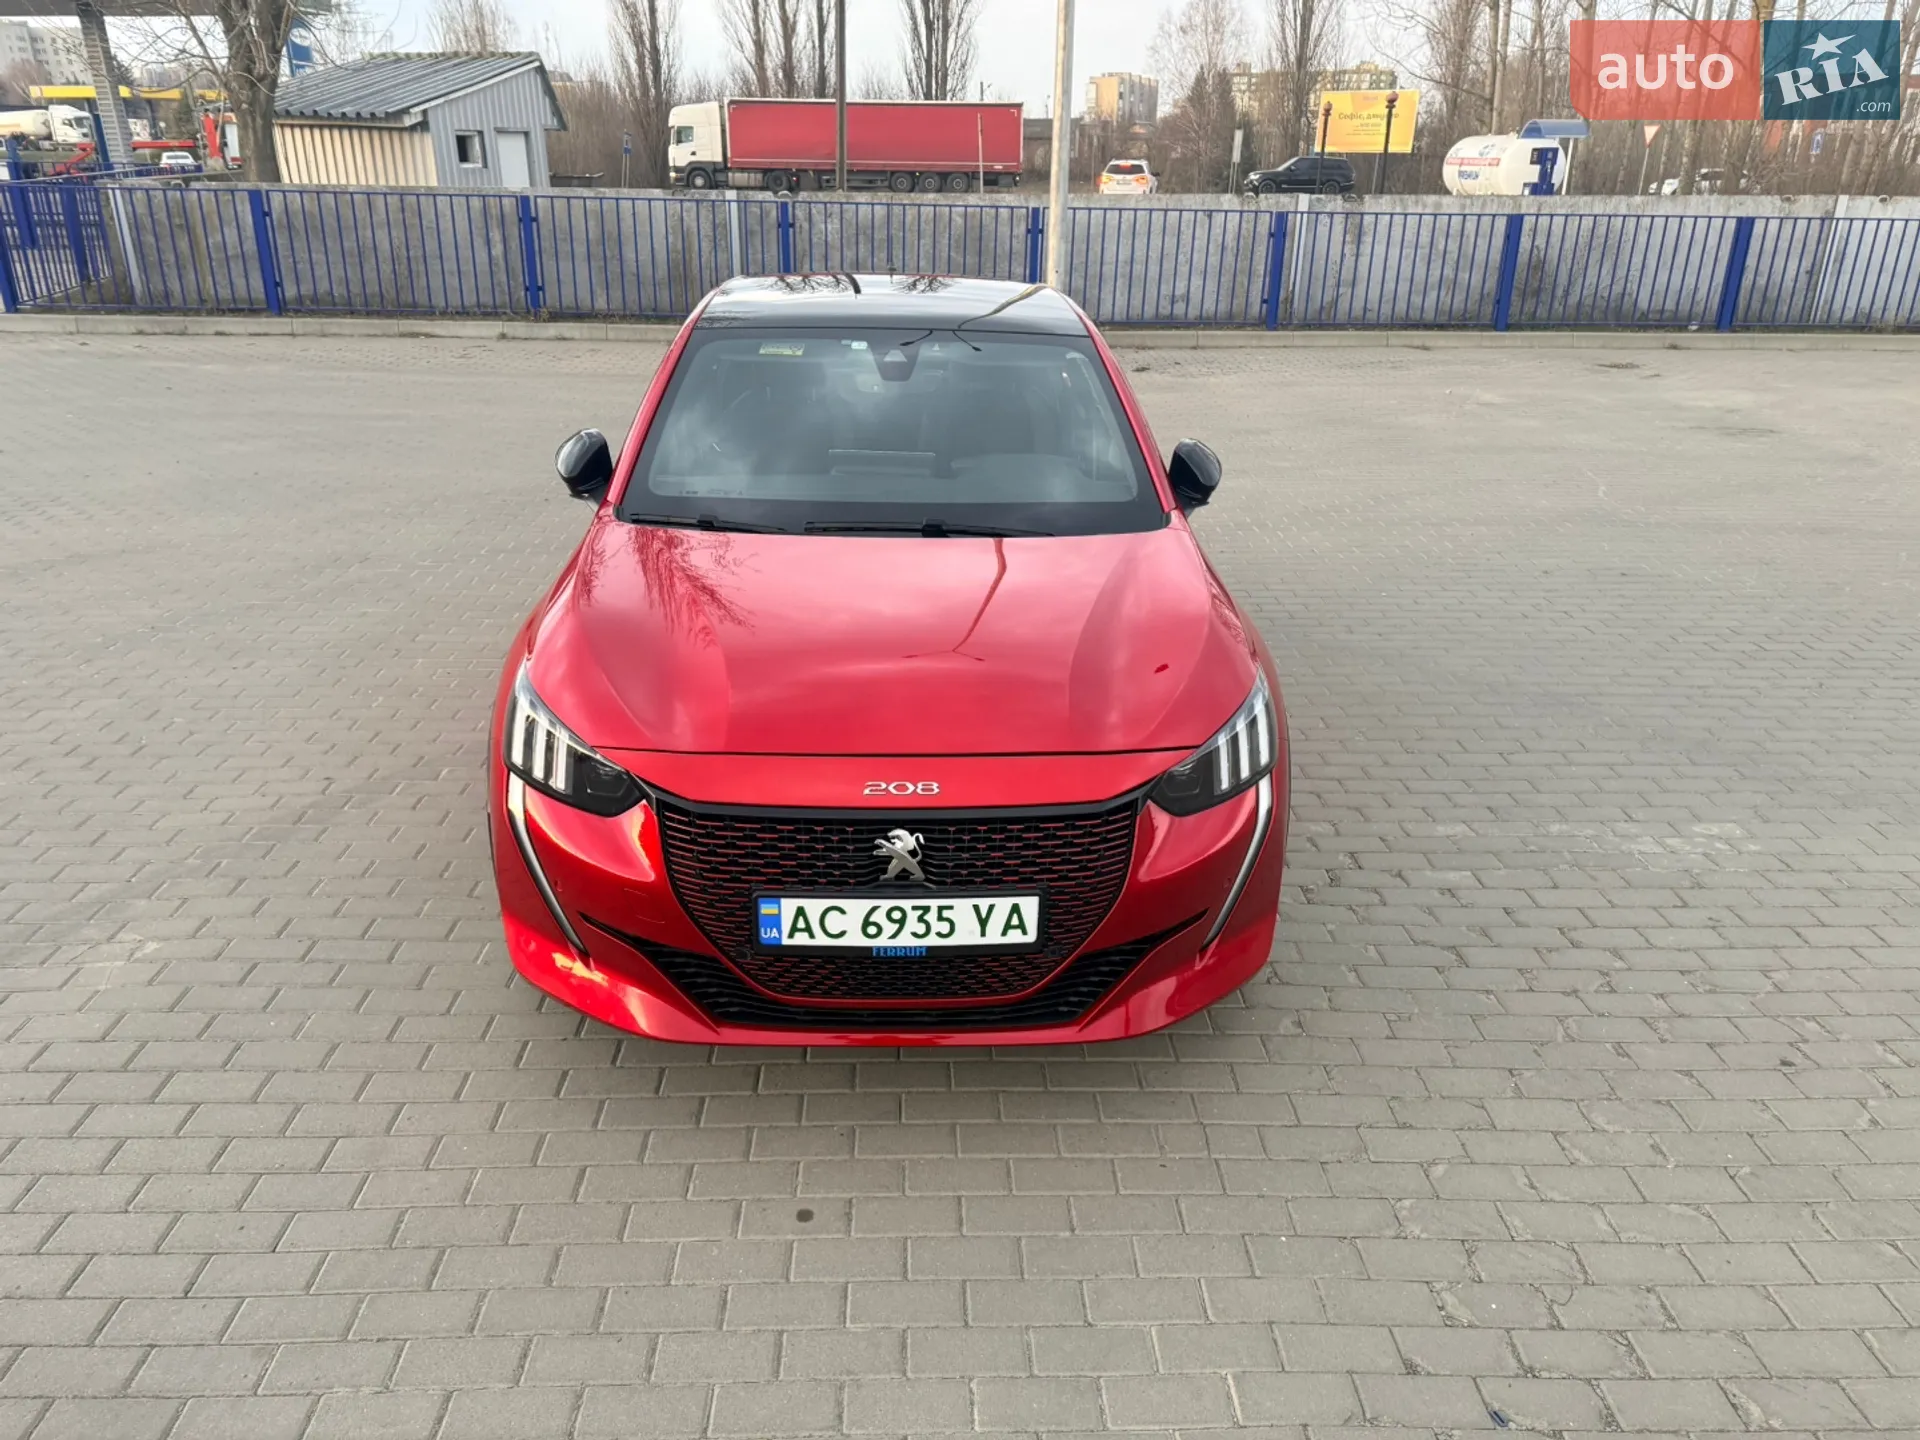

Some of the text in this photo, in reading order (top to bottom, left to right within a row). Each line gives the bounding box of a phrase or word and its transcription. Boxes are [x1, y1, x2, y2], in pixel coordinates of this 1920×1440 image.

[863, 781, 940, 796] 208
[787, 902, 1029, 940] AC 6935 YA
[761, 927, 780, 939] UA
[872, 946, 928, 957] FERRUM
